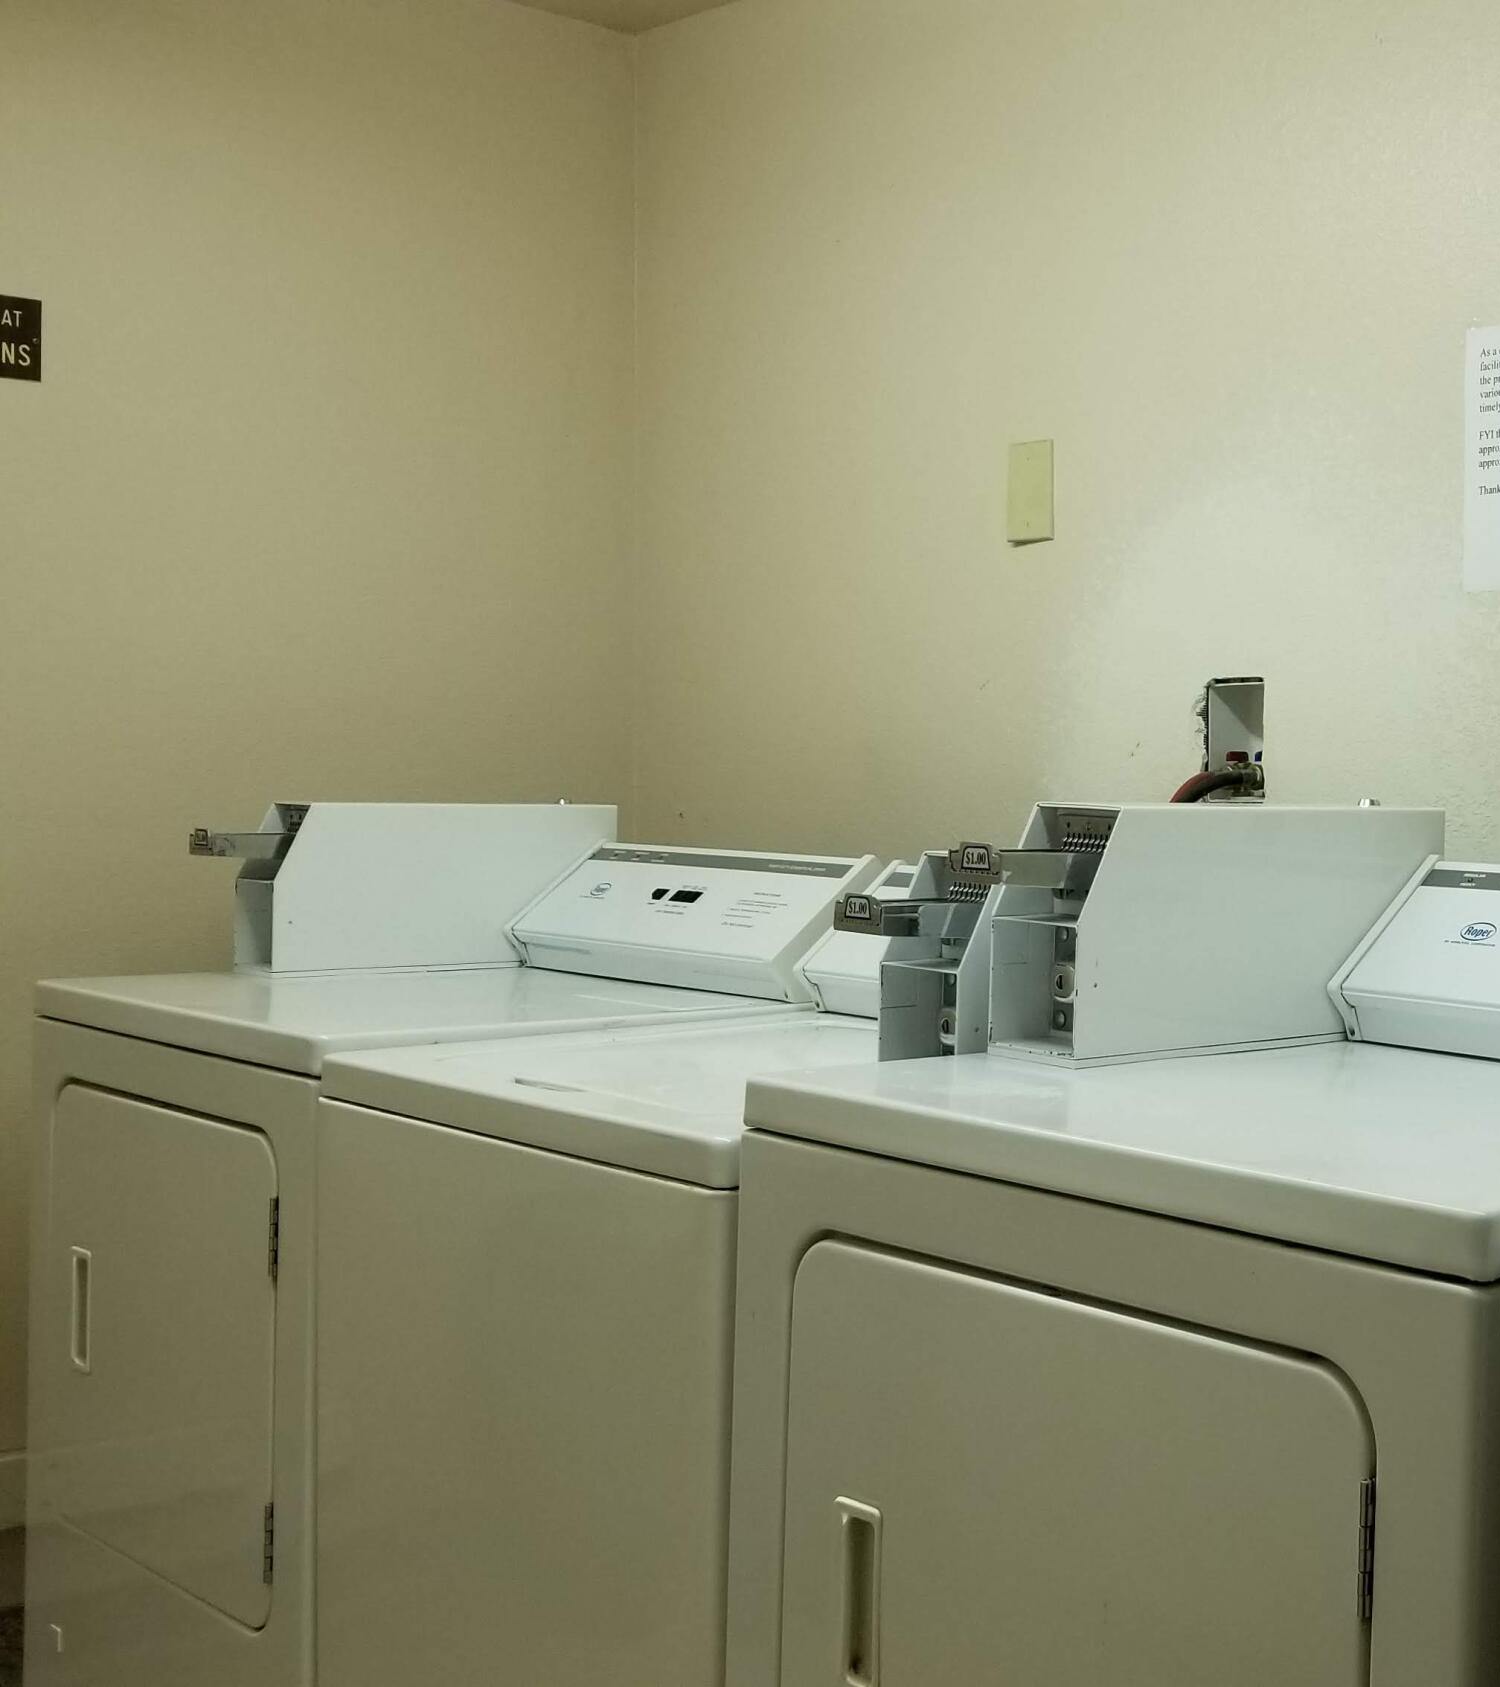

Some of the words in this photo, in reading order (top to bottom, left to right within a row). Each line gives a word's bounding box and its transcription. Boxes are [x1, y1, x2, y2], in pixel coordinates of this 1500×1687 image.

[1, 309, 22, 327] AT
[1480, 348, 1490, 357] As
[1480, 376, 1490, 385] the
[1480, 430, 1494, 440] FYI
[1479, 484, 1500, 495] Thank
[965, 851, 986, 865] $1.00
[849, 901, 867, 914] $1.00
[1464, 926, 1494, 938] Roper
